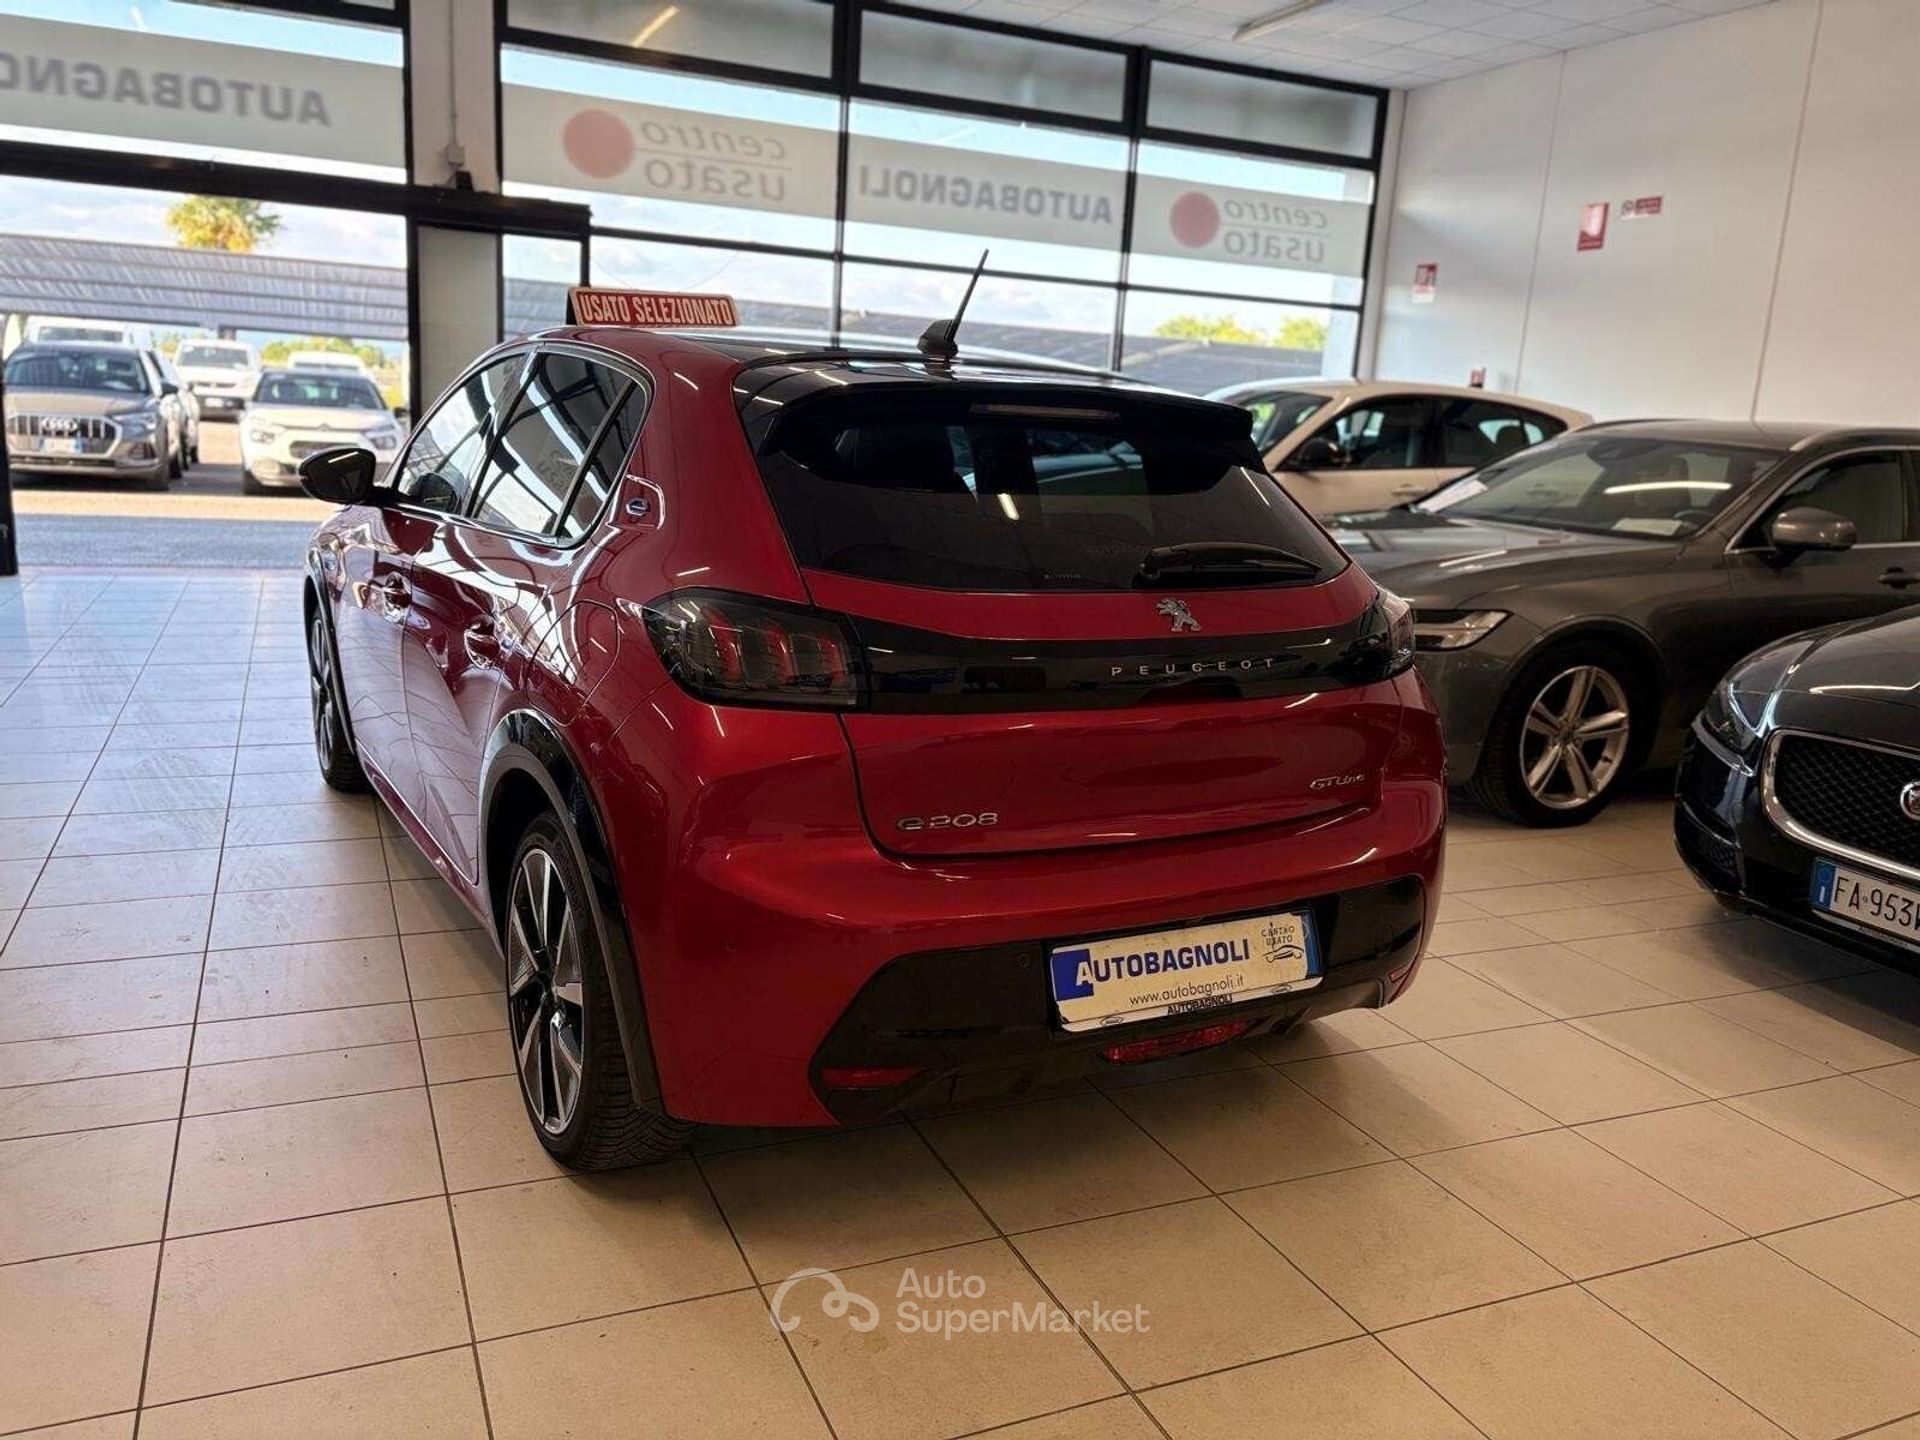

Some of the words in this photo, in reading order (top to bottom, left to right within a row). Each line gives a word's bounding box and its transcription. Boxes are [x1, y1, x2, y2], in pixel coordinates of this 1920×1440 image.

[579, 294, 631, 322] USATO
[631, 296, 734, 326] SELEZIONATO
[1111, 657, 1275, 677] PEUGEOT
[1075, 938, 1250, 987] AUTOBAGNOLI
[1129, 973, 1244, 1006] www.autobagnoli.it
[1166, 994, 1233, 1015] AUTOBAGNOLI
